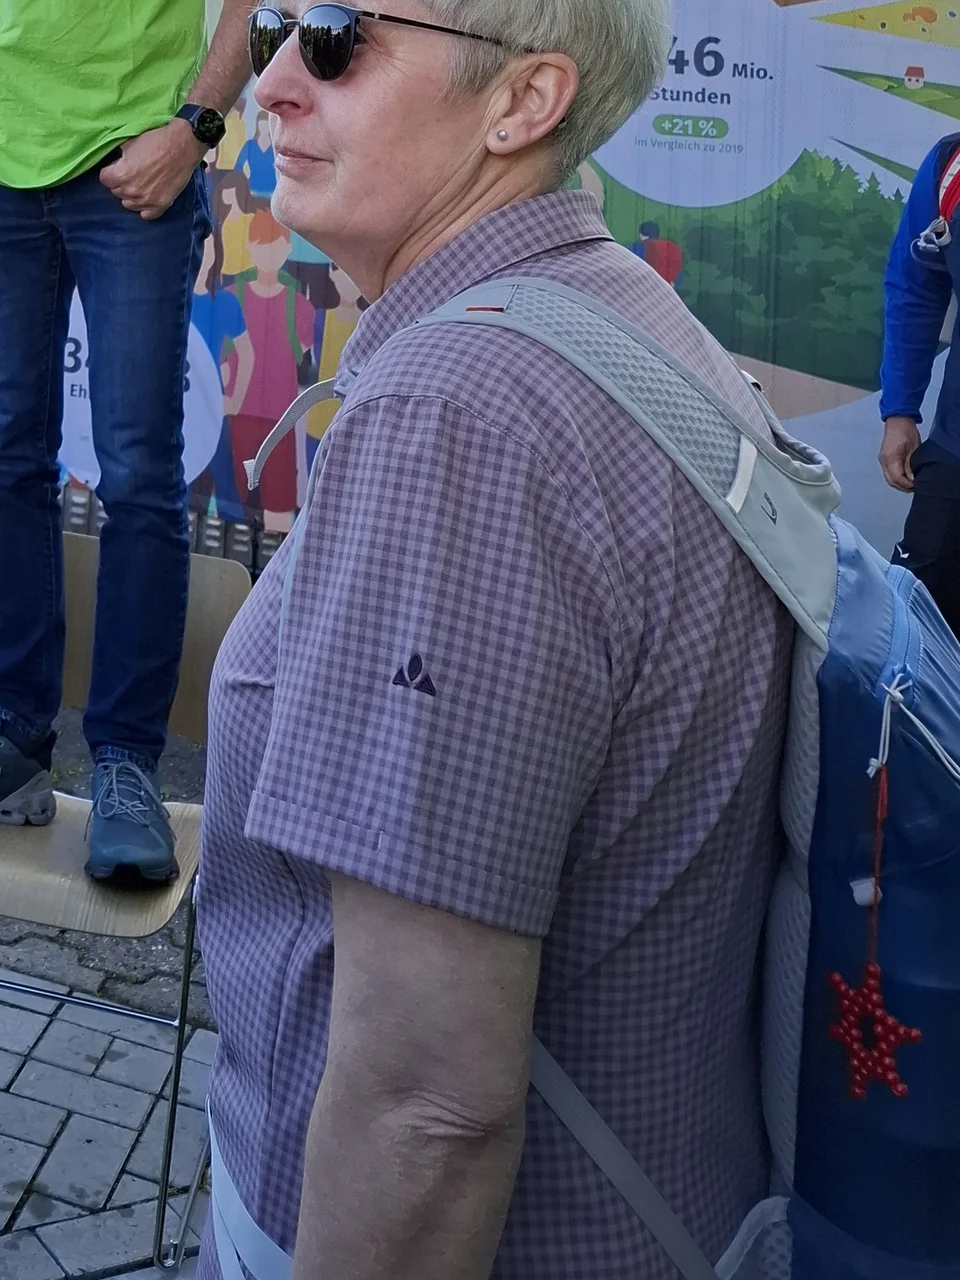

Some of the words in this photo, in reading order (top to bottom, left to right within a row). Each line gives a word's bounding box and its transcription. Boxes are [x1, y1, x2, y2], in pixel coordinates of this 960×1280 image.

[732, 62, 774, 80] Mio.
[662, 118, 693, 135] +21
[698, 120, 717, 137] %
[635, 137, 647, 147] im
[650, 137, 700, 152] Vergleich
[703, 144, 715, 152] zu
[719, 144, 744, 154] 2019
